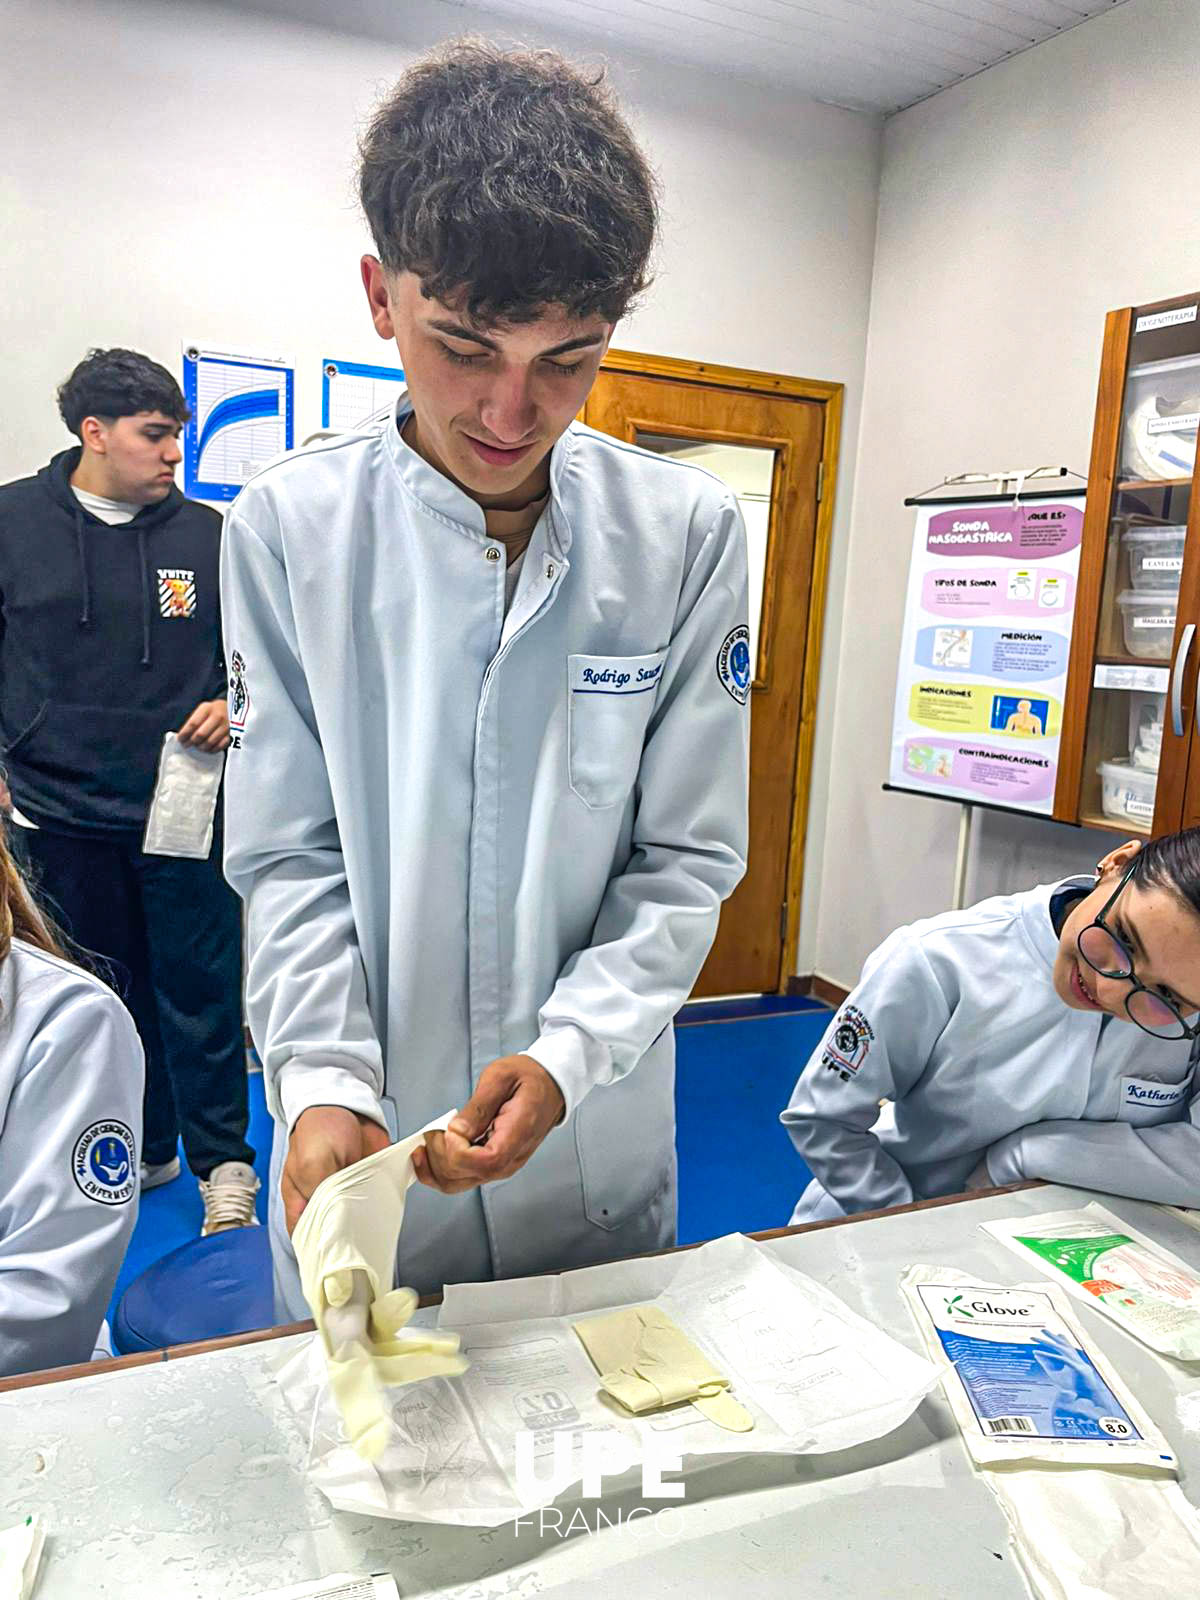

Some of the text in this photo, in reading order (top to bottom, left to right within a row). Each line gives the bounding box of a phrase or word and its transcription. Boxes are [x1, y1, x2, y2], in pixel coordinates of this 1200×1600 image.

[952, 521, 990, 532] SONDA
[583, 668, 631, 688] Rodrigo
[919, 686, 972, 698] INDICACIONES
[959, 748, 1048, 768] CONTRAINDICACIONES
[1105, 1423, 1128, 1434] 8.0
